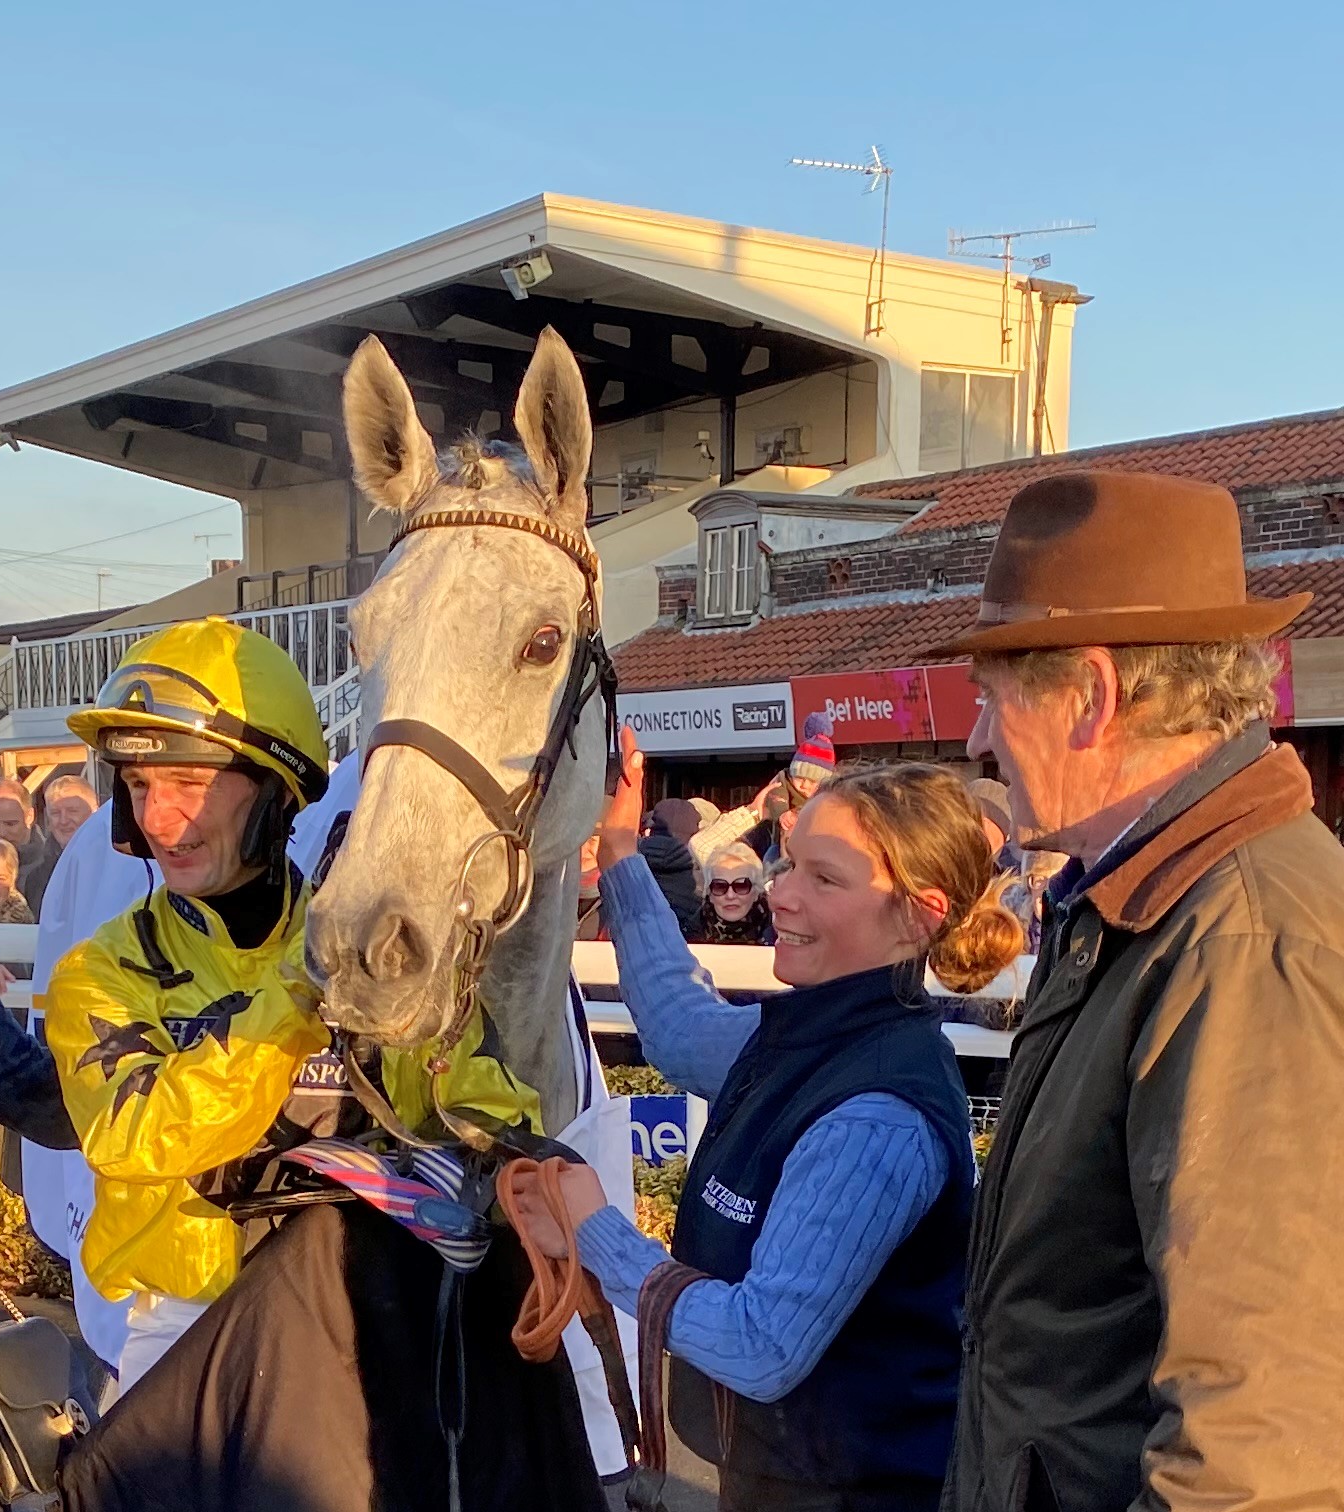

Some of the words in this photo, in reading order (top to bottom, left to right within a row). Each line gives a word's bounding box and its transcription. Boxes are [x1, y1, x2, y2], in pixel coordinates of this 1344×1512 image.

[624, 708, 722, 733] CONNECTIONS
[735, 706, 769, 727] Racing
[767, 704, 784, 722] TV
[824, 697, 852, 723] Bet
[854, 696, 894, 721] Here
